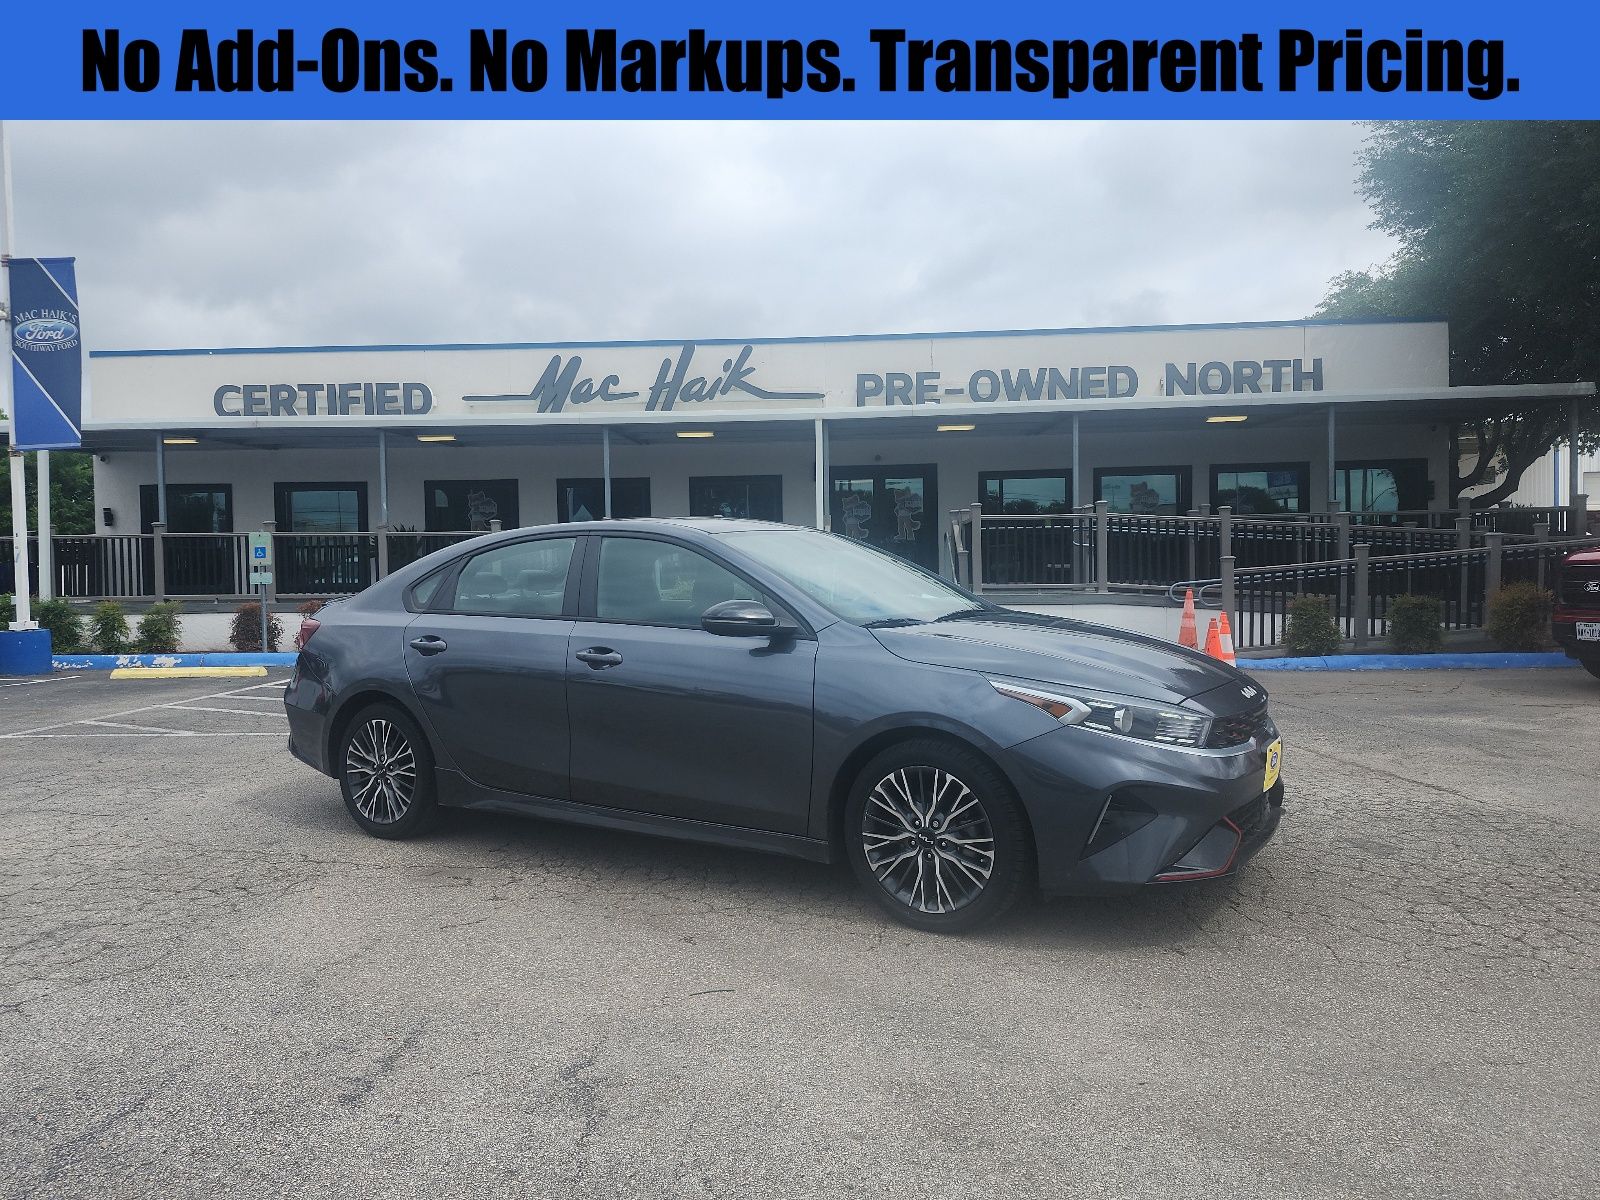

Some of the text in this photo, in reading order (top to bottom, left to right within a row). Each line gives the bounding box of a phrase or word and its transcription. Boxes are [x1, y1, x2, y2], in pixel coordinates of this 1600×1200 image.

[14, 309, 78, 324] MAC HAIK'S
[25, 322, 65, 340] Ford
[15, 339, 78, 352] SOUTHWAY FORD
[462, 343, 825, 413] Mac Haik
[856, 358, 1323, 407] PRE-OWNED NORTH
[213, 382, 432, 416] CERTIFIED
